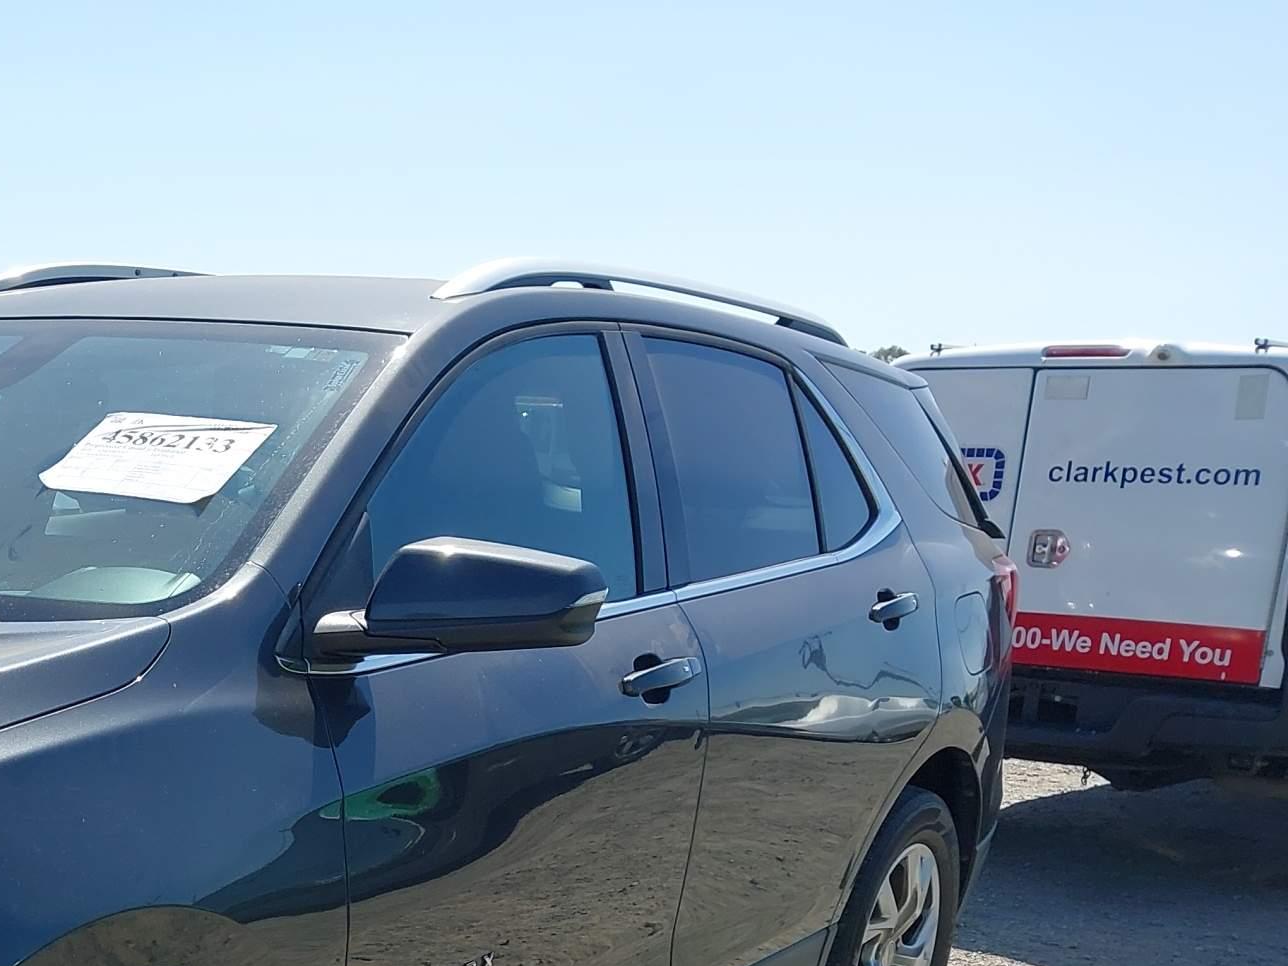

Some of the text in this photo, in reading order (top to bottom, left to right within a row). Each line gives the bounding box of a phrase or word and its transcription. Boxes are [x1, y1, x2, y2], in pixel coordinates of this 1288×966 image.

[100, 429, 237, 454] 45862133
[1048, 460, 1261, 489] clarkpest.com
[1099, 632, 1172, 661] Need
[1179, 638, 1232, 667] You
